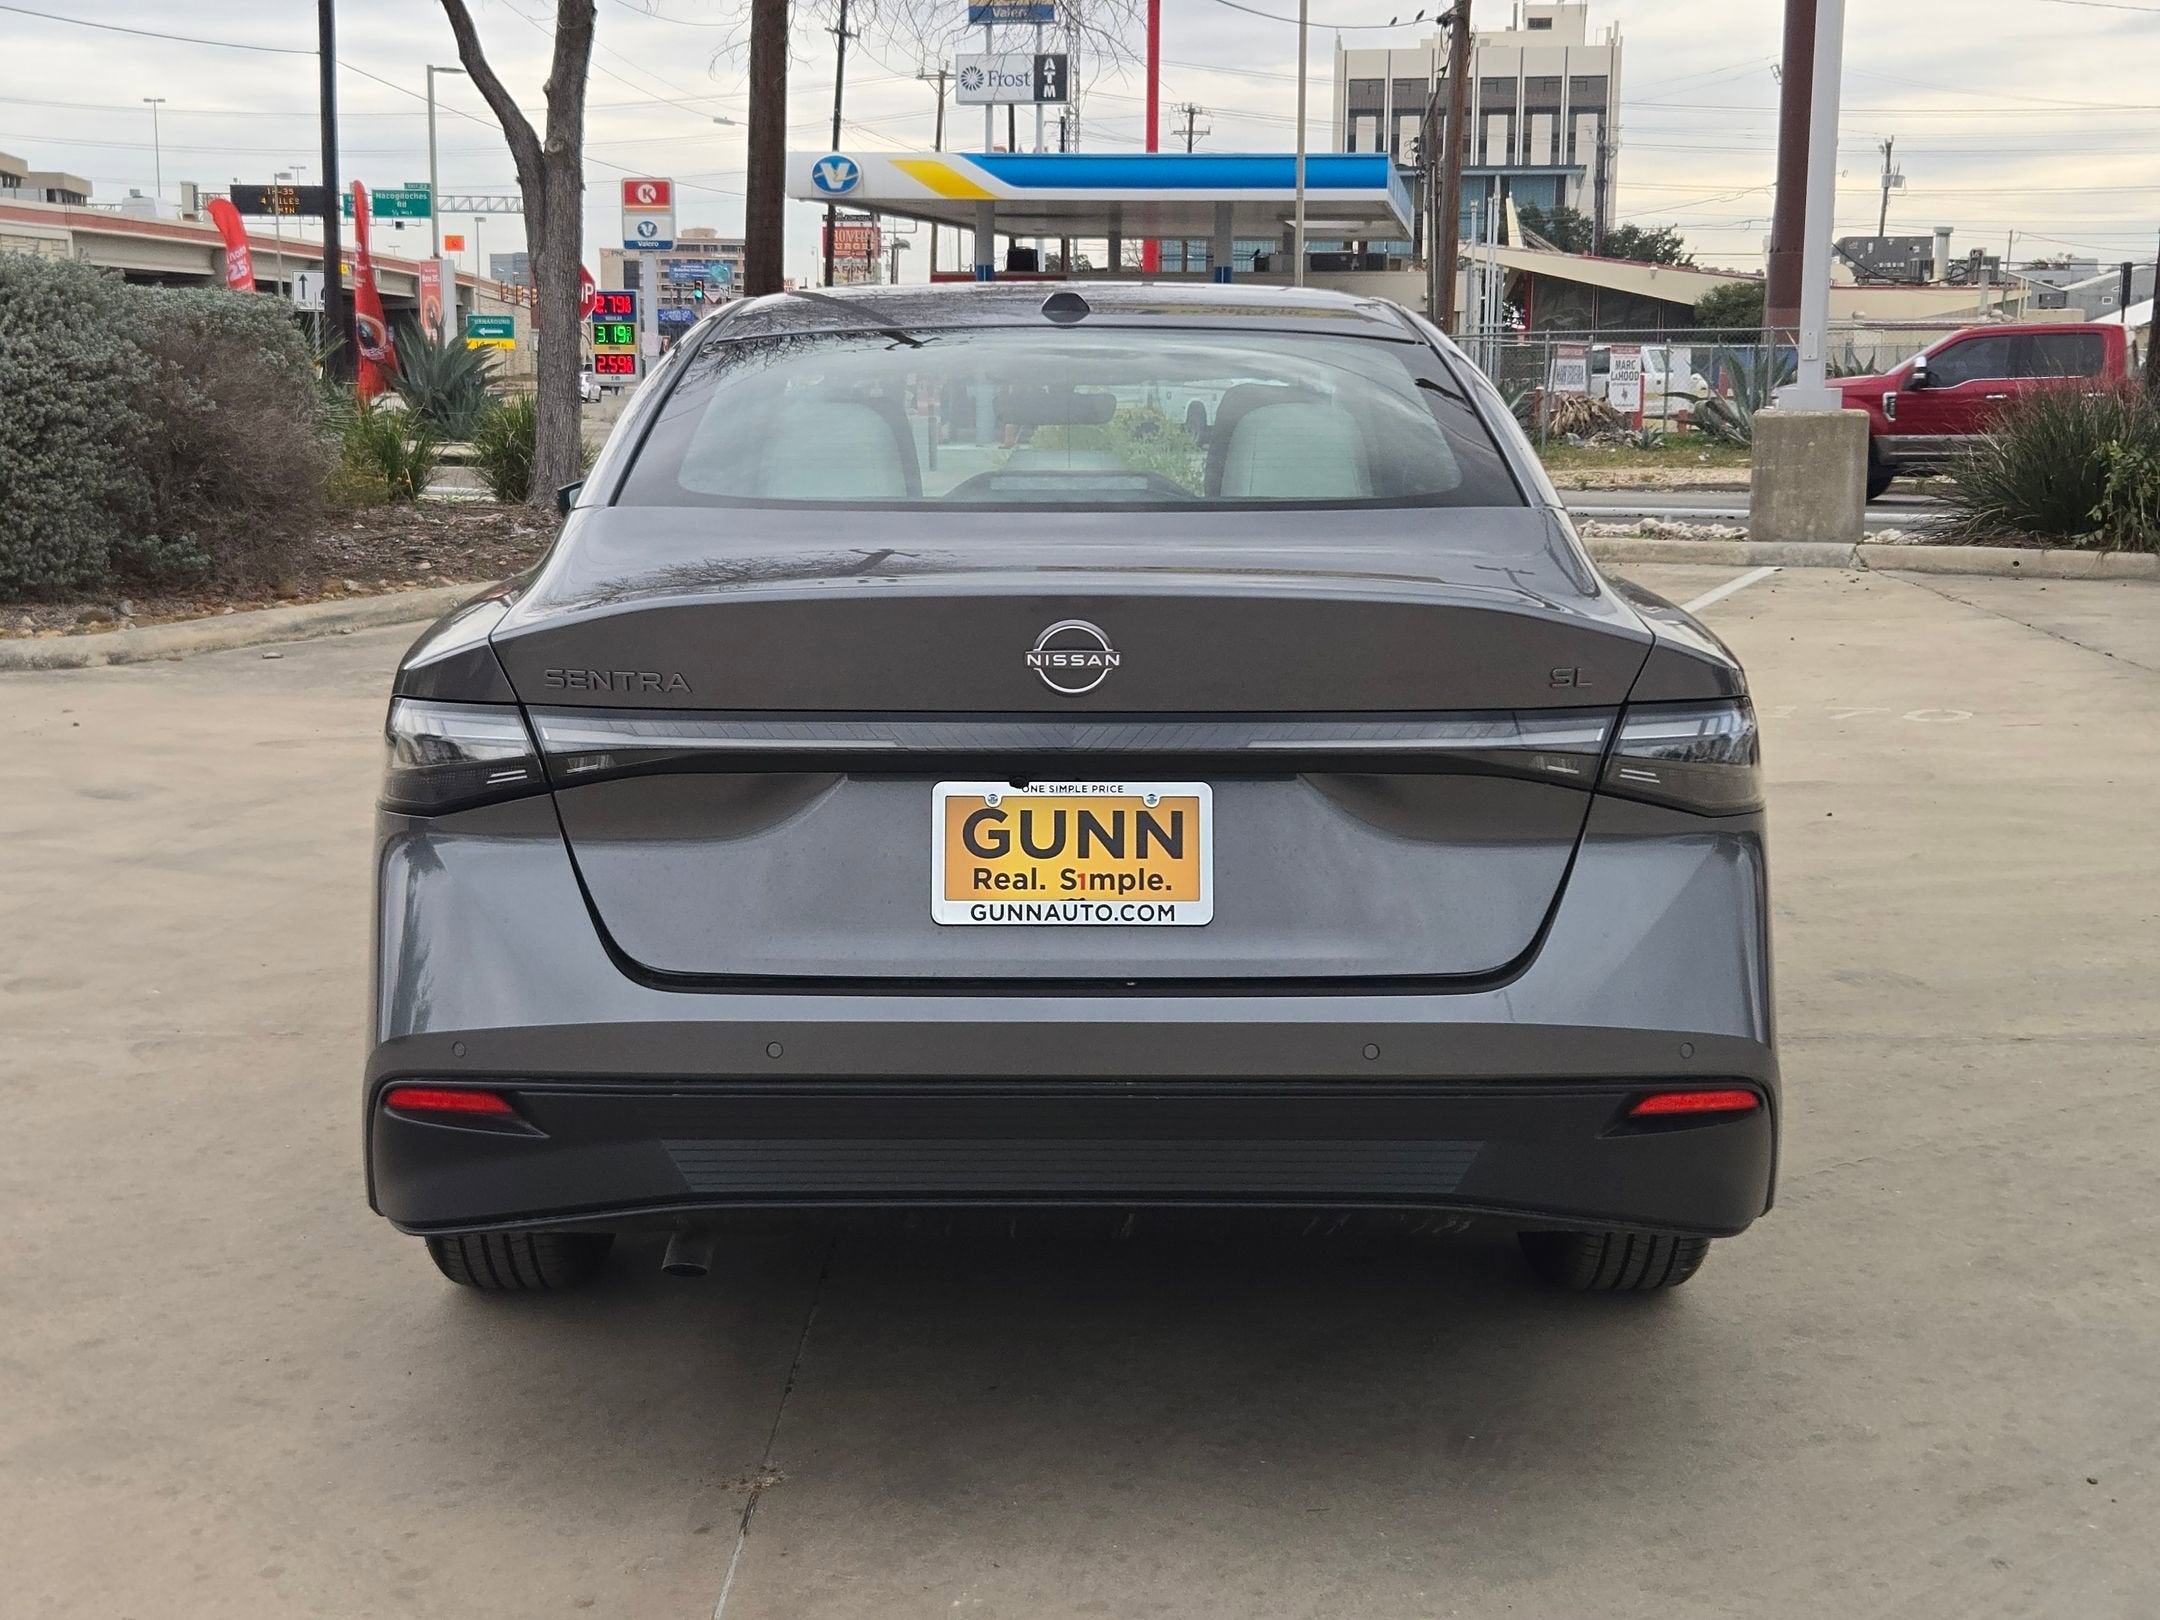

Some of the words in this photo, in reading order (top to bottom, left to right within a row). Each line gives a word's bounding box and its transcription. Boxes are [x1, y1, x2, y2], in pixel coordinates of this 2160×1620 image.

[987, 71, 1031, 87] Frost
[1043, 58, 1056, 98] ATM
[1615, 360, 1636, 370] MARC
[1027, 654, 1120, 666] NISSAN
[543, 668, 693, 693] SENTRA
[1549, 667, 1592, 688] SL
[1022, 785, 1045, 793] ONE
[1049, 785, 1088, 793] SIMPLE
[1091, 785, 1125, 793] PRICE
[962, 808, 1184, 860] GUNN
[973, 868, 1046, 890] Real.
[970, 904, 1176, 922] GUNNAUTO.COM
